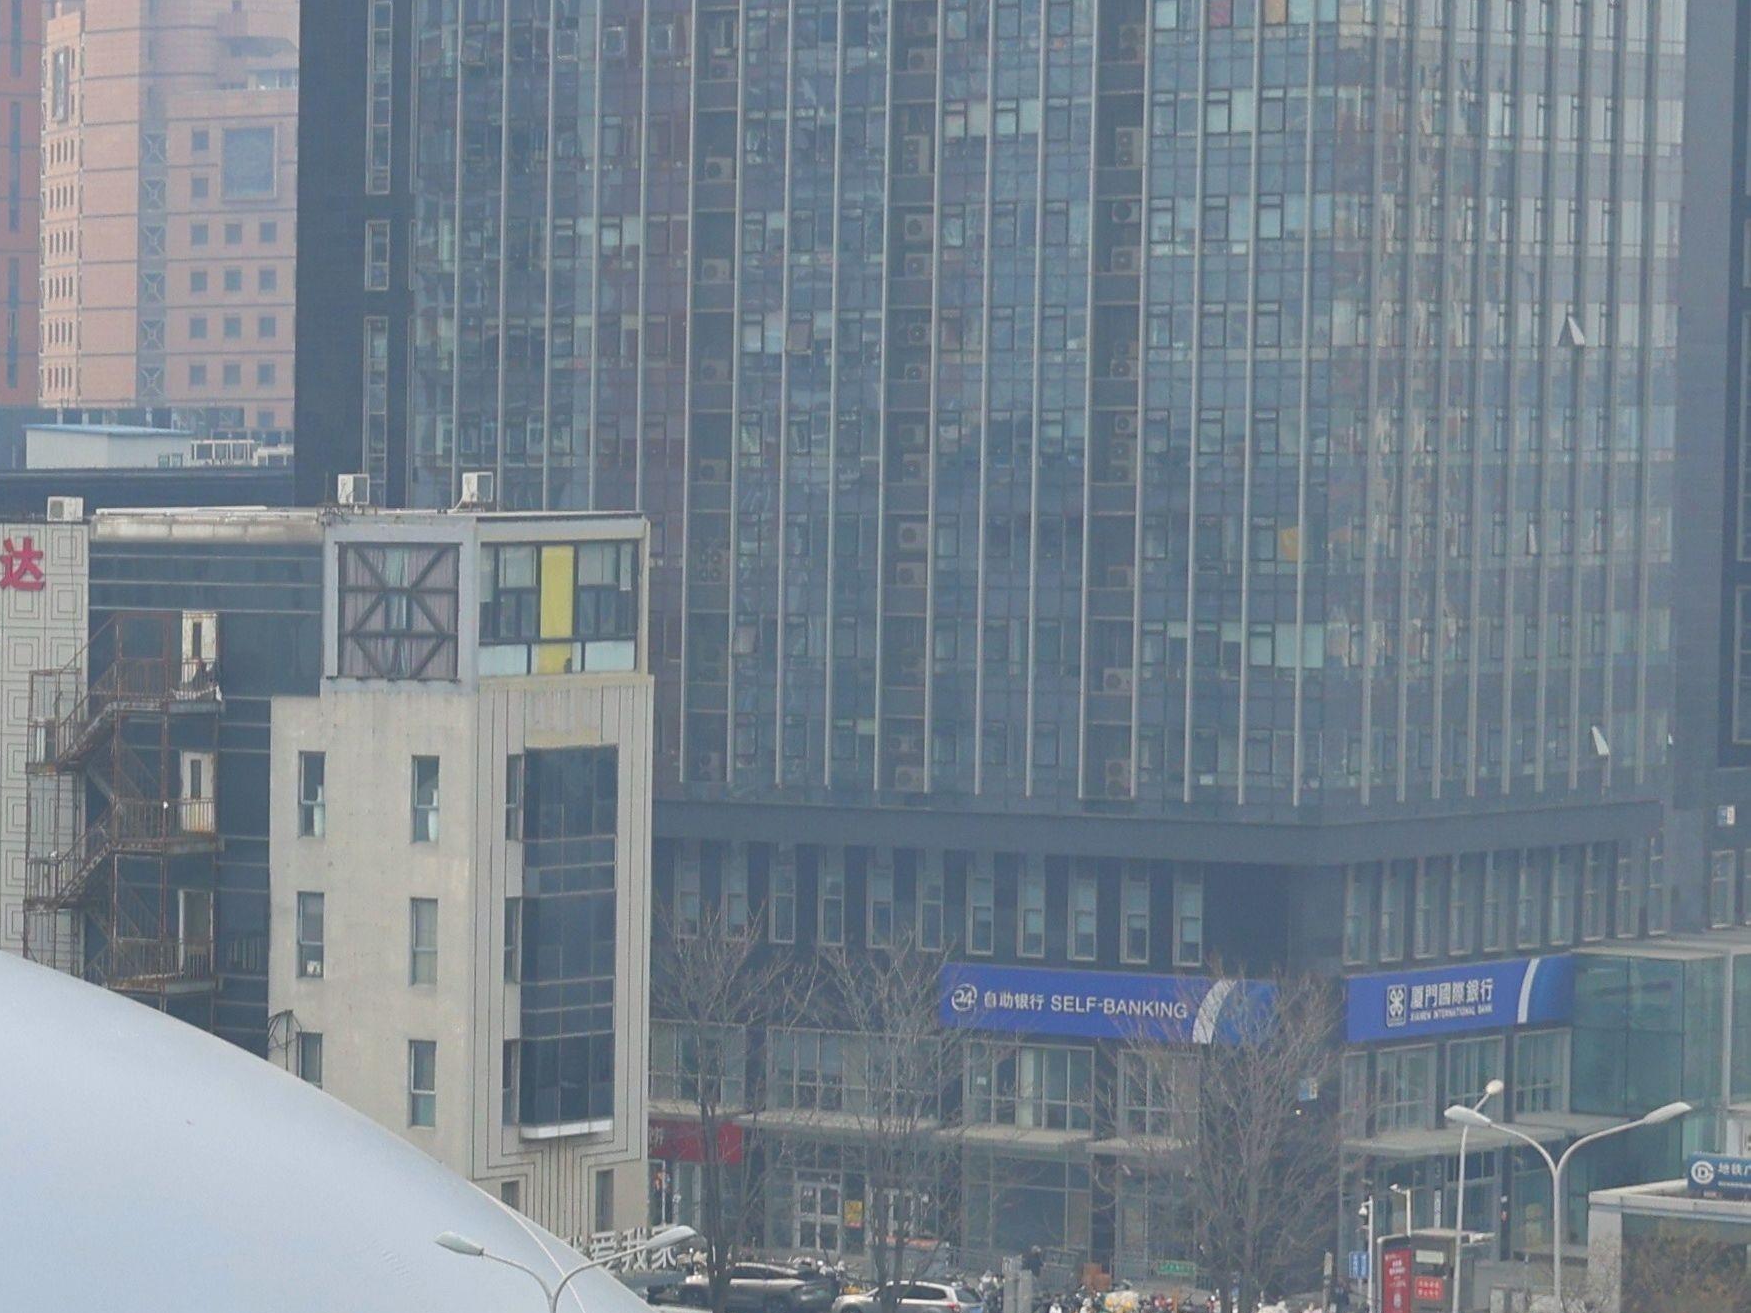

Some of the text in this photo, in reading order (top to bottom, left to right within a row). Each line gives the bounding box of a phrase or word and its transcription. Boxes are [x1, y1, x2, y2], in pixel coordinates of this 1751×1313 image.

[983, 990, 1045, 1012] 自助银行
[1050, 995, 1188, 1019] SELF-BANKING
